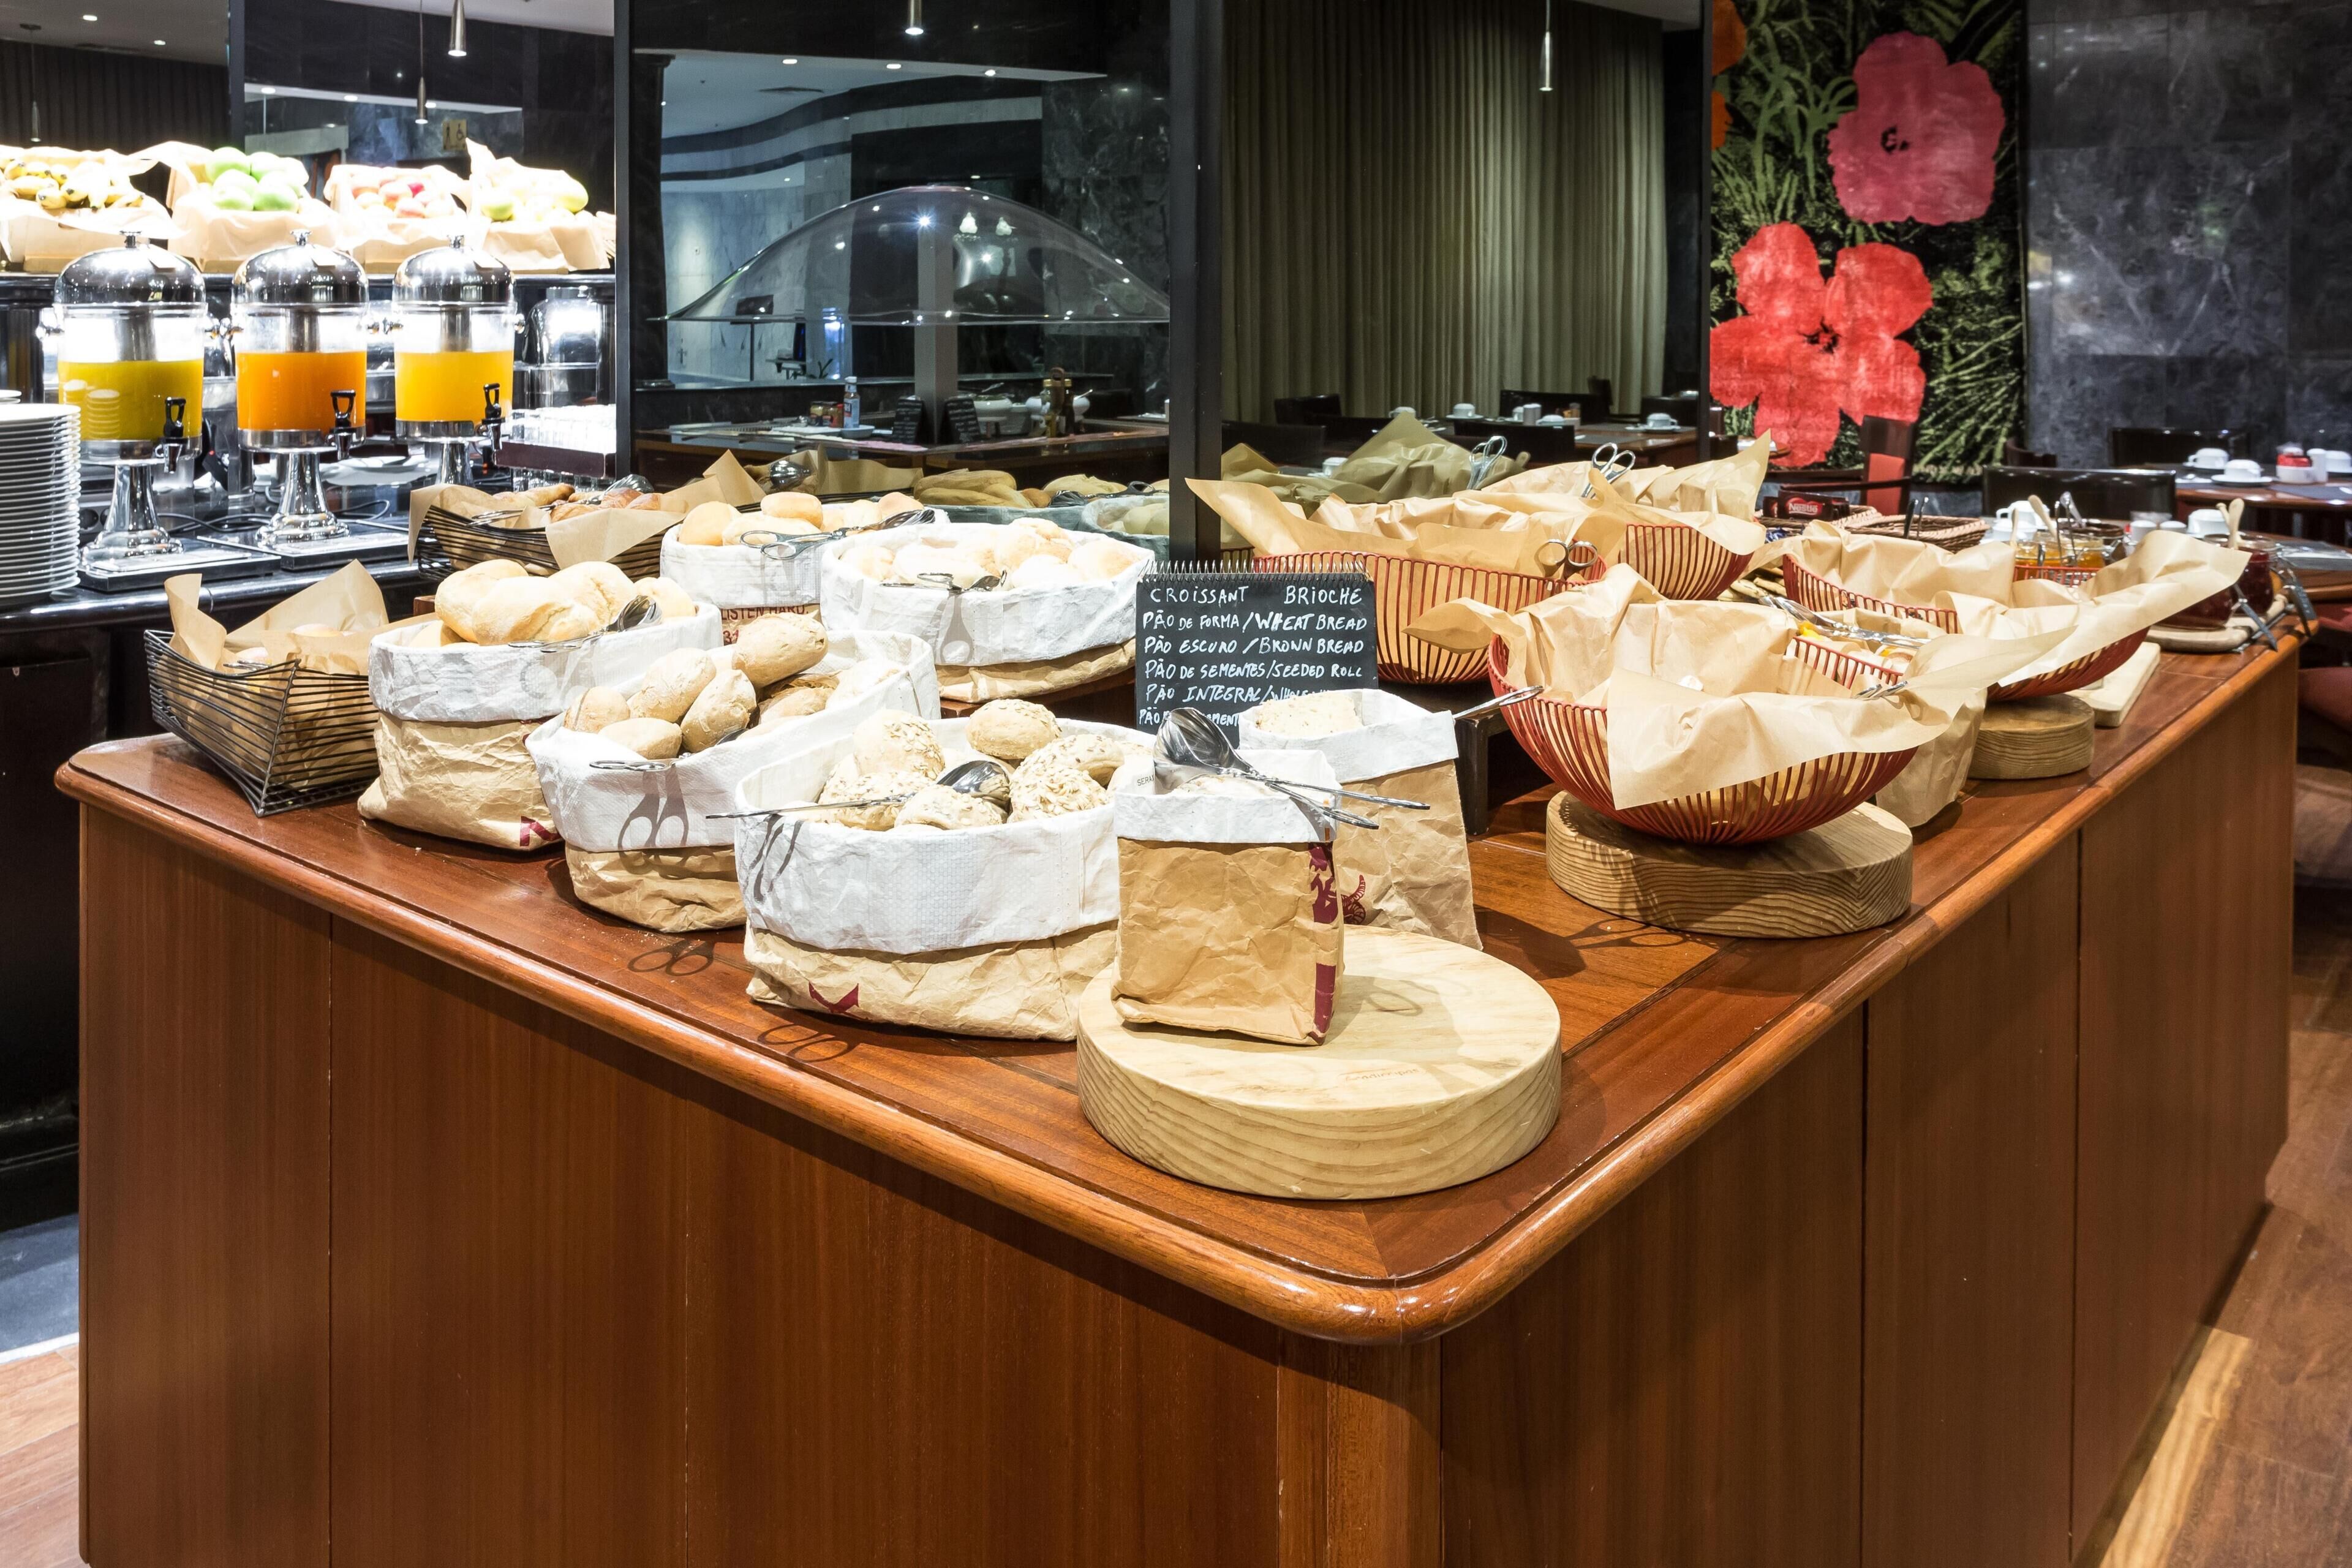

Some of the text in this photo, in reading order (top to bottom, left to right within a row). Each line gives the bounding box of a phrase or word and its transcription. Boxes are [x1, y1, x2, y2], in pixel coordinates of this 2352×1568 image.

[1143, 609, 1175, 630] PÃO
[1178, 617, 1193, 631] DE
[1315, 614, 1367, 631] BREAD
[1144, 635, 1172, 654] PÃO
[1317, 638, 1364, 654] BREAD
[1145, 658, 1177, 679] PÃO
[1180, 665, 1195, 679] DE
[1330, 663, 1363, 678] ROLL
[1146, 683, 1175, 704] PÃO
